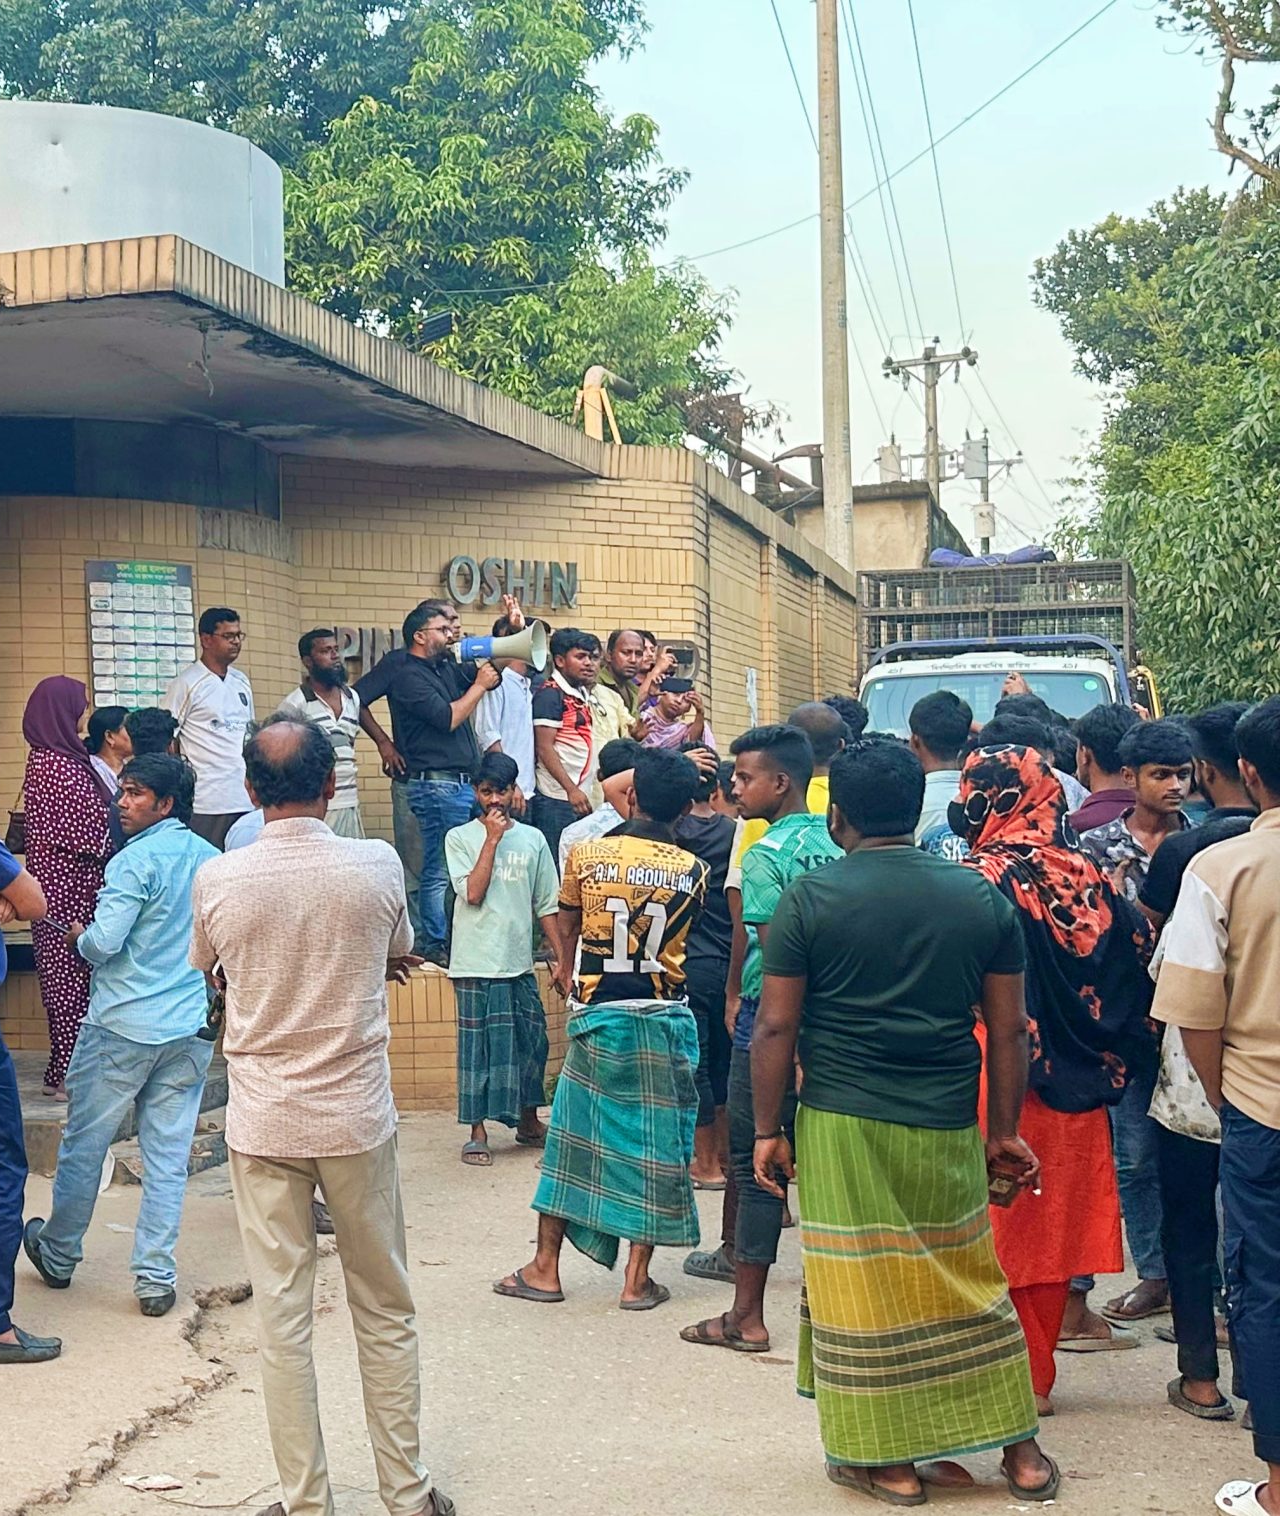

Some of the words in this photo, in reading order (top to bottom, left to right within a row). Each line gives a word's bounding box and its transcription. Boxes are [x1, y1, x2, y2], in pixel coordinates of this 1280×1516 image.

[447, 555, 577, 609] OSHIN
[594, 863, 622, 882] A.M.
[626, 866, 693, 893] ABDULLAH
[603, 897, 668, 973] 11
